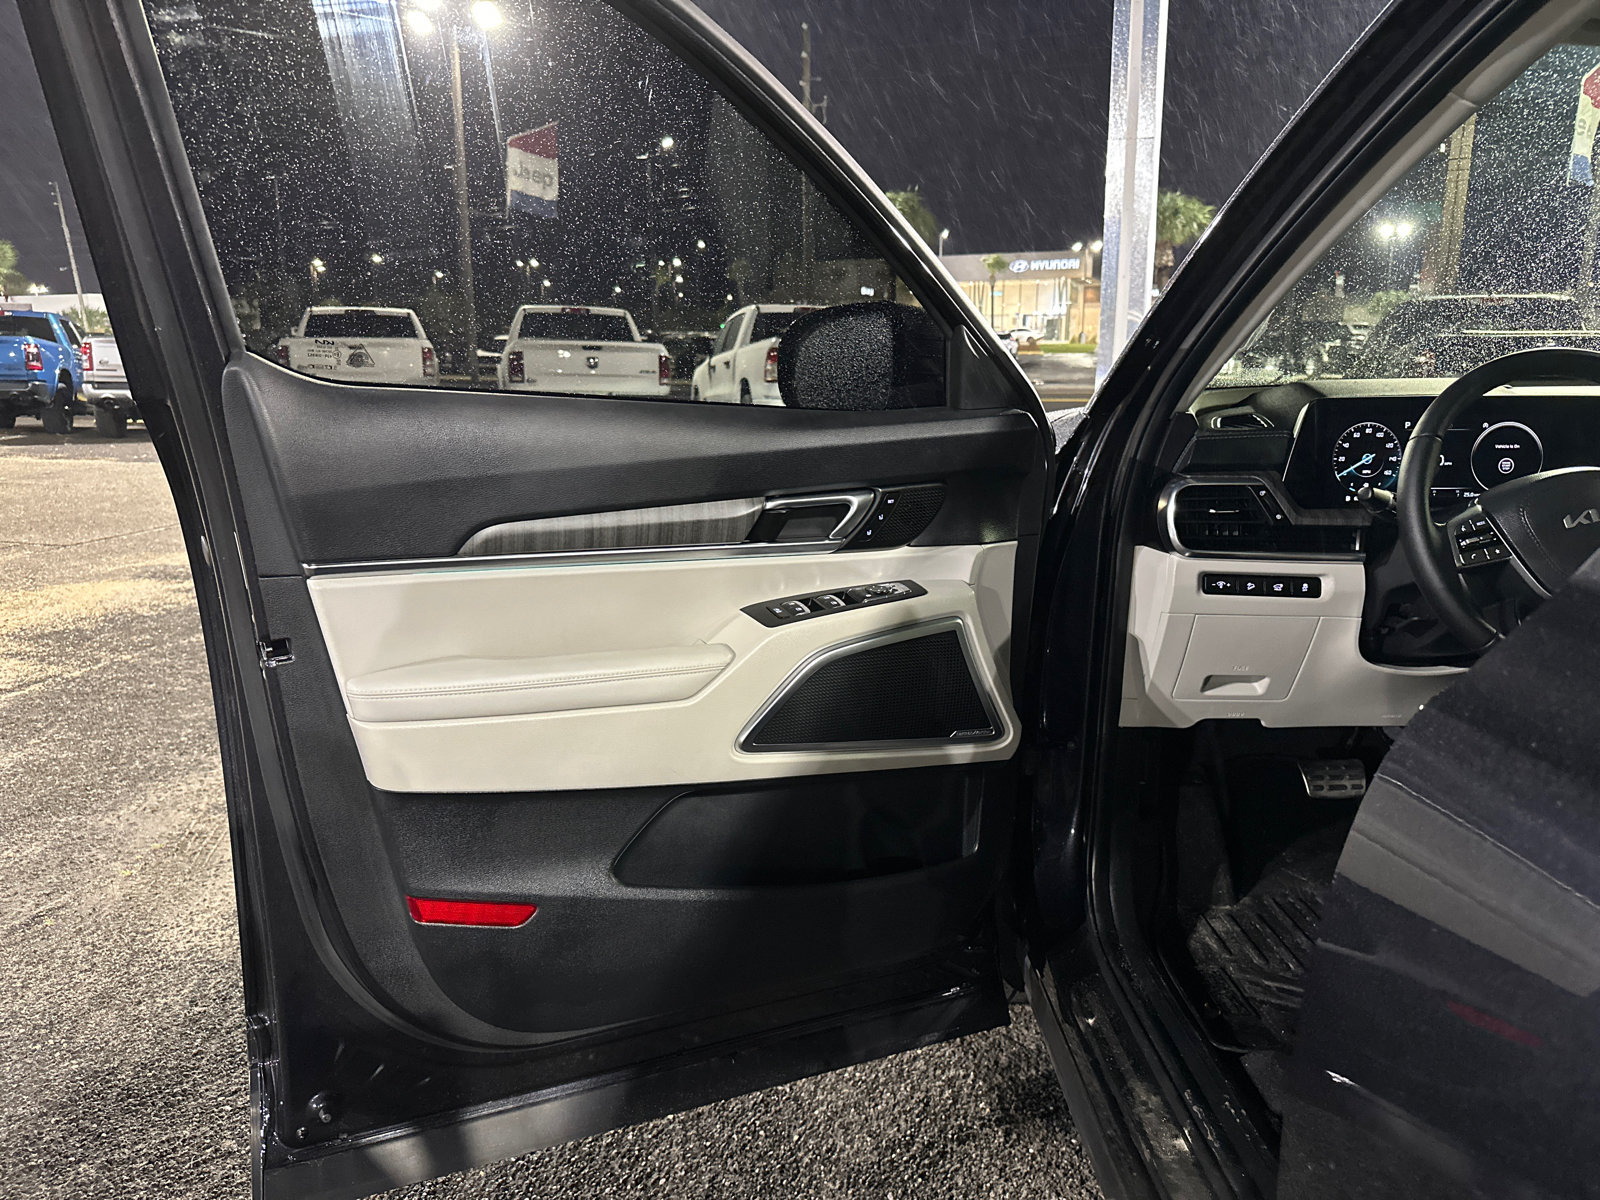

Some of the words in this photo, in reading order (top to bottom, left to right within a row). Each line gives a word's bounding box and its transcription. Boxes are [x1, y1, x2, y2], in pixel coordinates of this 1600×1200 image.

[513, 162, 554, 190] Jeep
[1030, 258, 1080, 271] HYUNDAI
[1404, 421, 1411, 429] P
